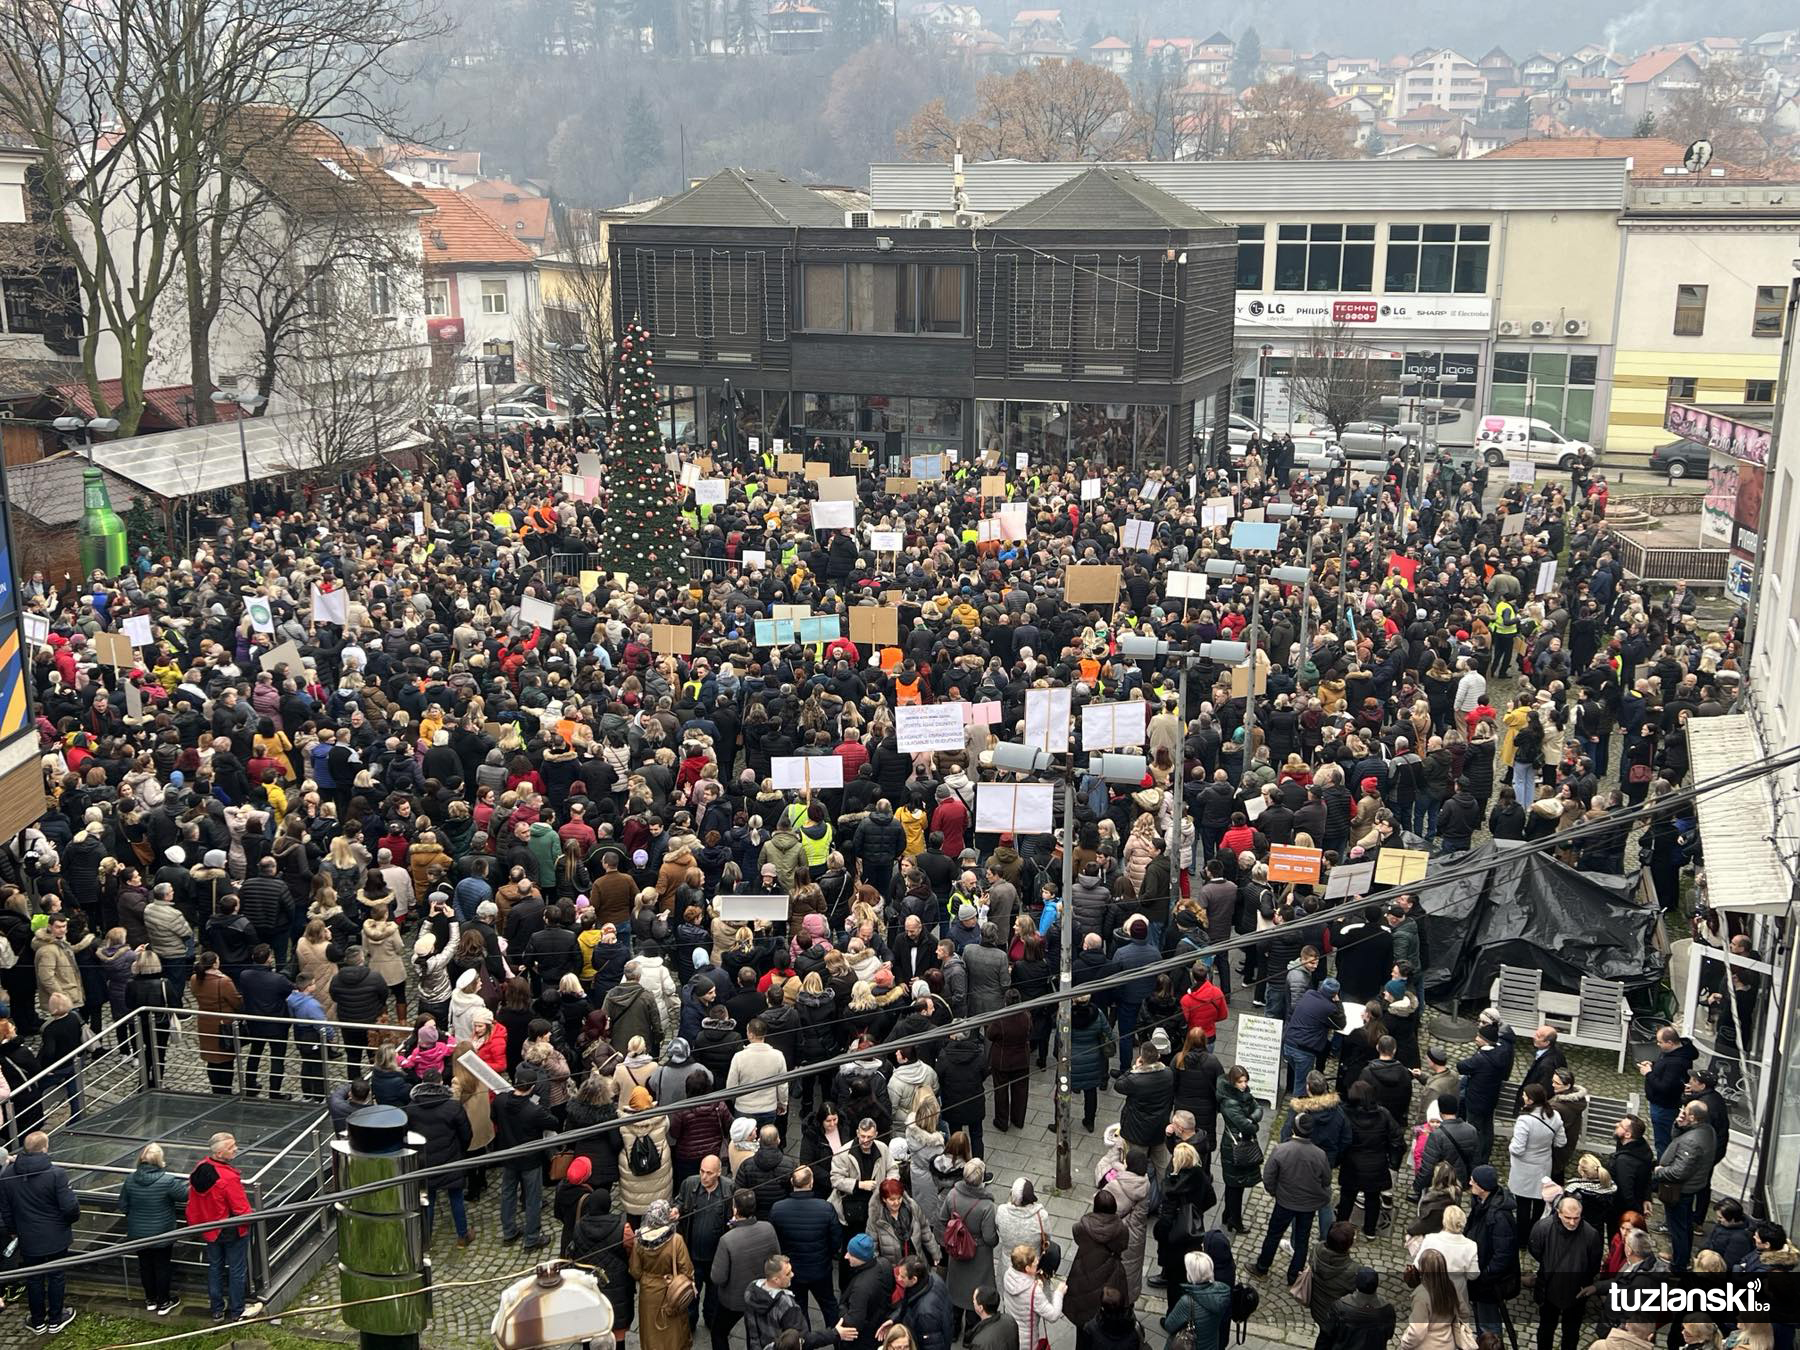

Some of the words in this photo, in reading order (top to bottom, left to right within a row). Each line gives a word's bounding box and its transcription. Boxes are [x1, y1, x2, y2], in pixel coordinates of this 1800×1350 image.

[1267, 303, 1285, 314] LG
[1335, 304, 1376, 312] TECHNO
[1408, 365, 1436, 374] IQOS
[1445, 366, 1474, 374] IQOS
